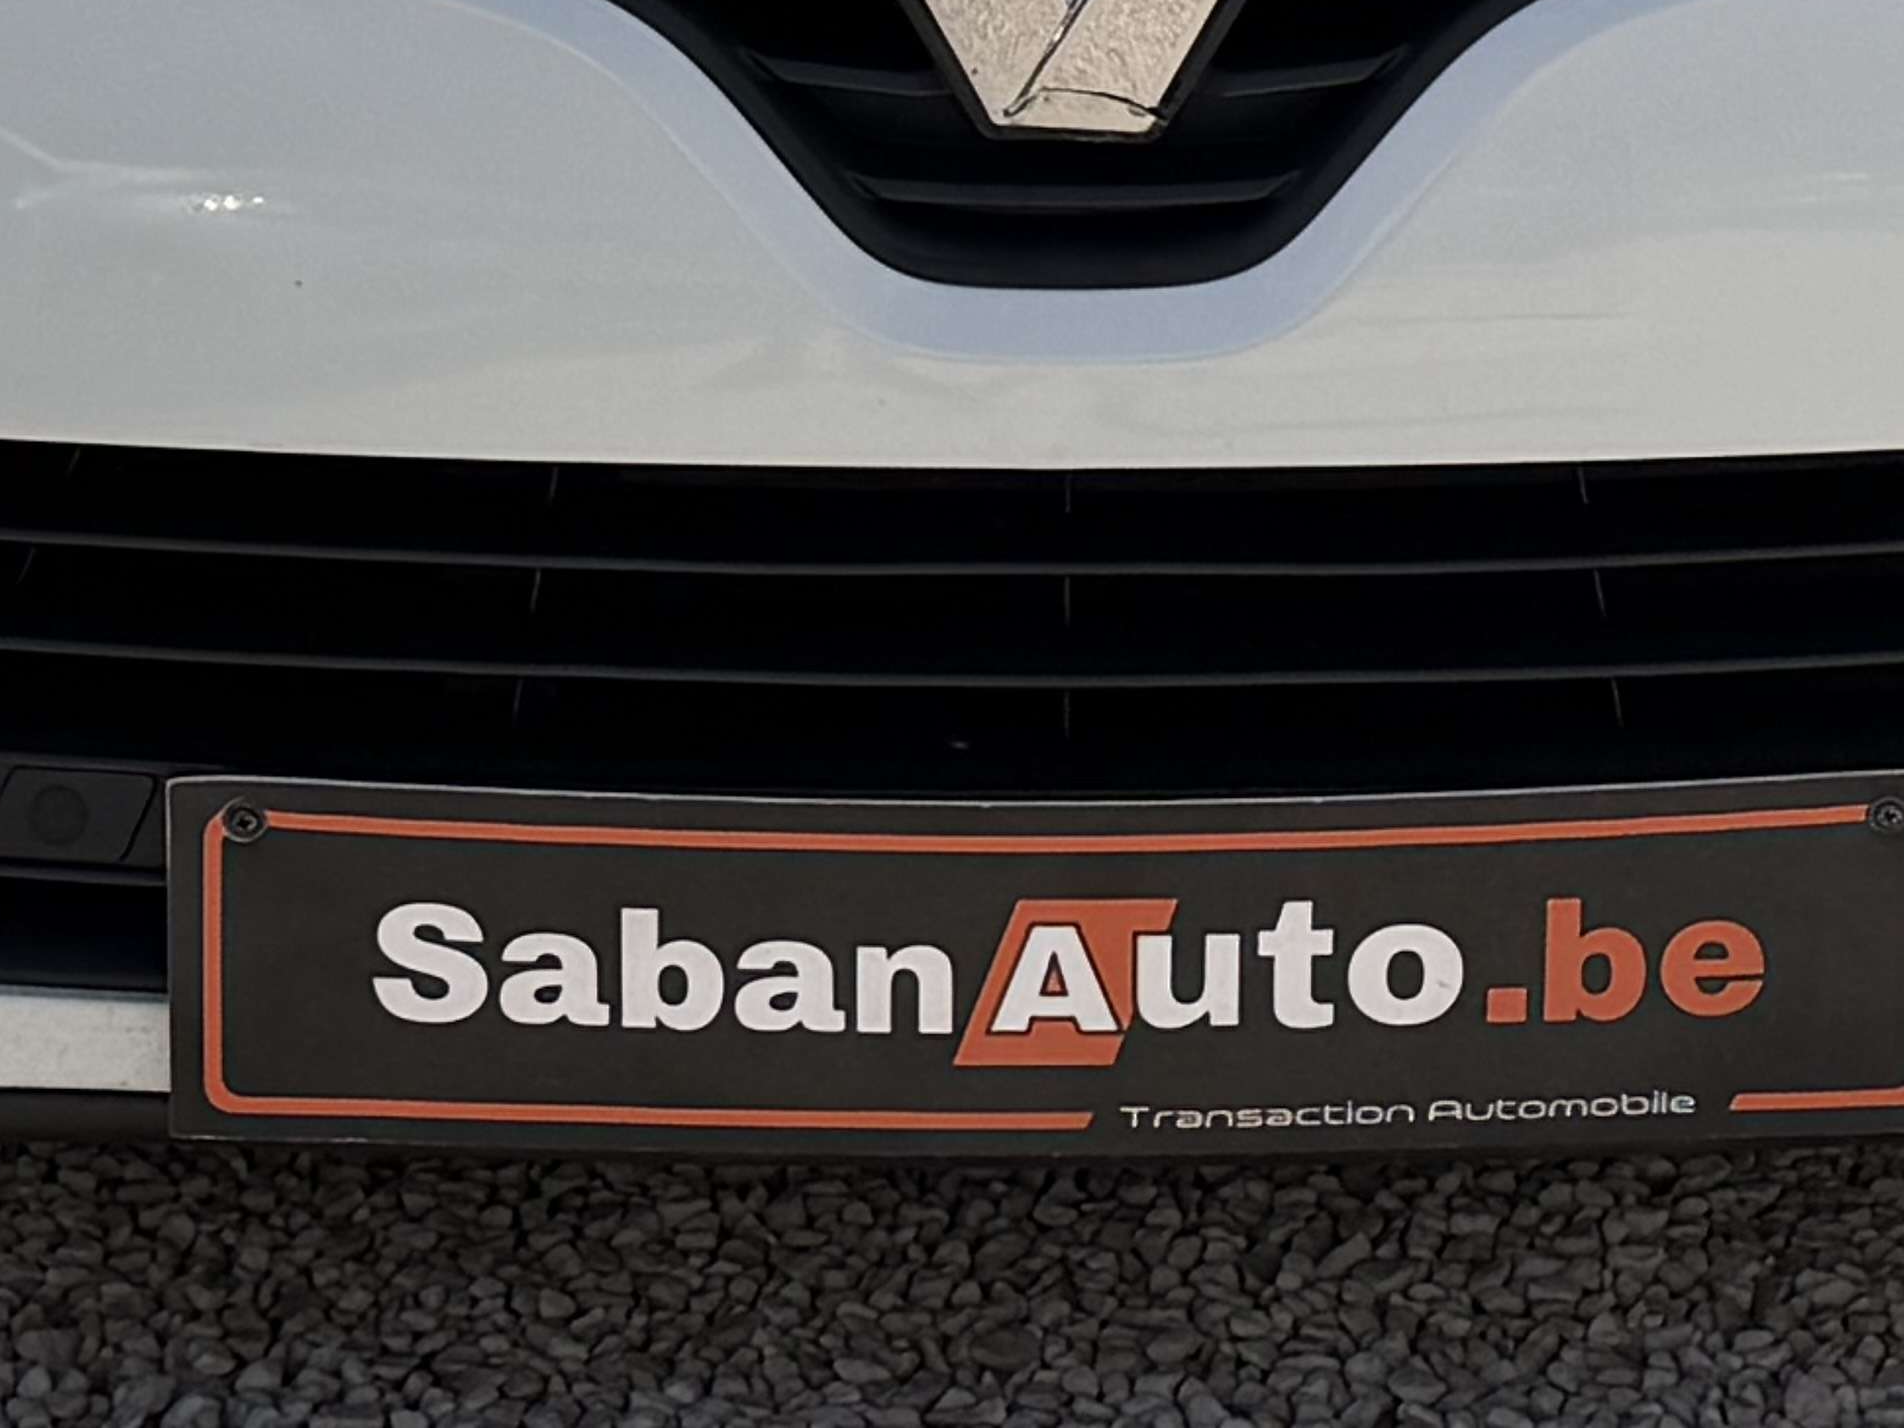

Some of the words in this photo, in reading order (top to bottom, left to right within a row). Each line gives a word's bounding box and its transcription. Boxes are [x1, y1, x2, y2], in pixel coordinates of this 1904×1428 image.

[371, 898, 1766, 1034] SabanAuto.be
[1119, 1100, 1416, 1129] Transaction
[1427, 1089, 1696, 1122] Automobile
